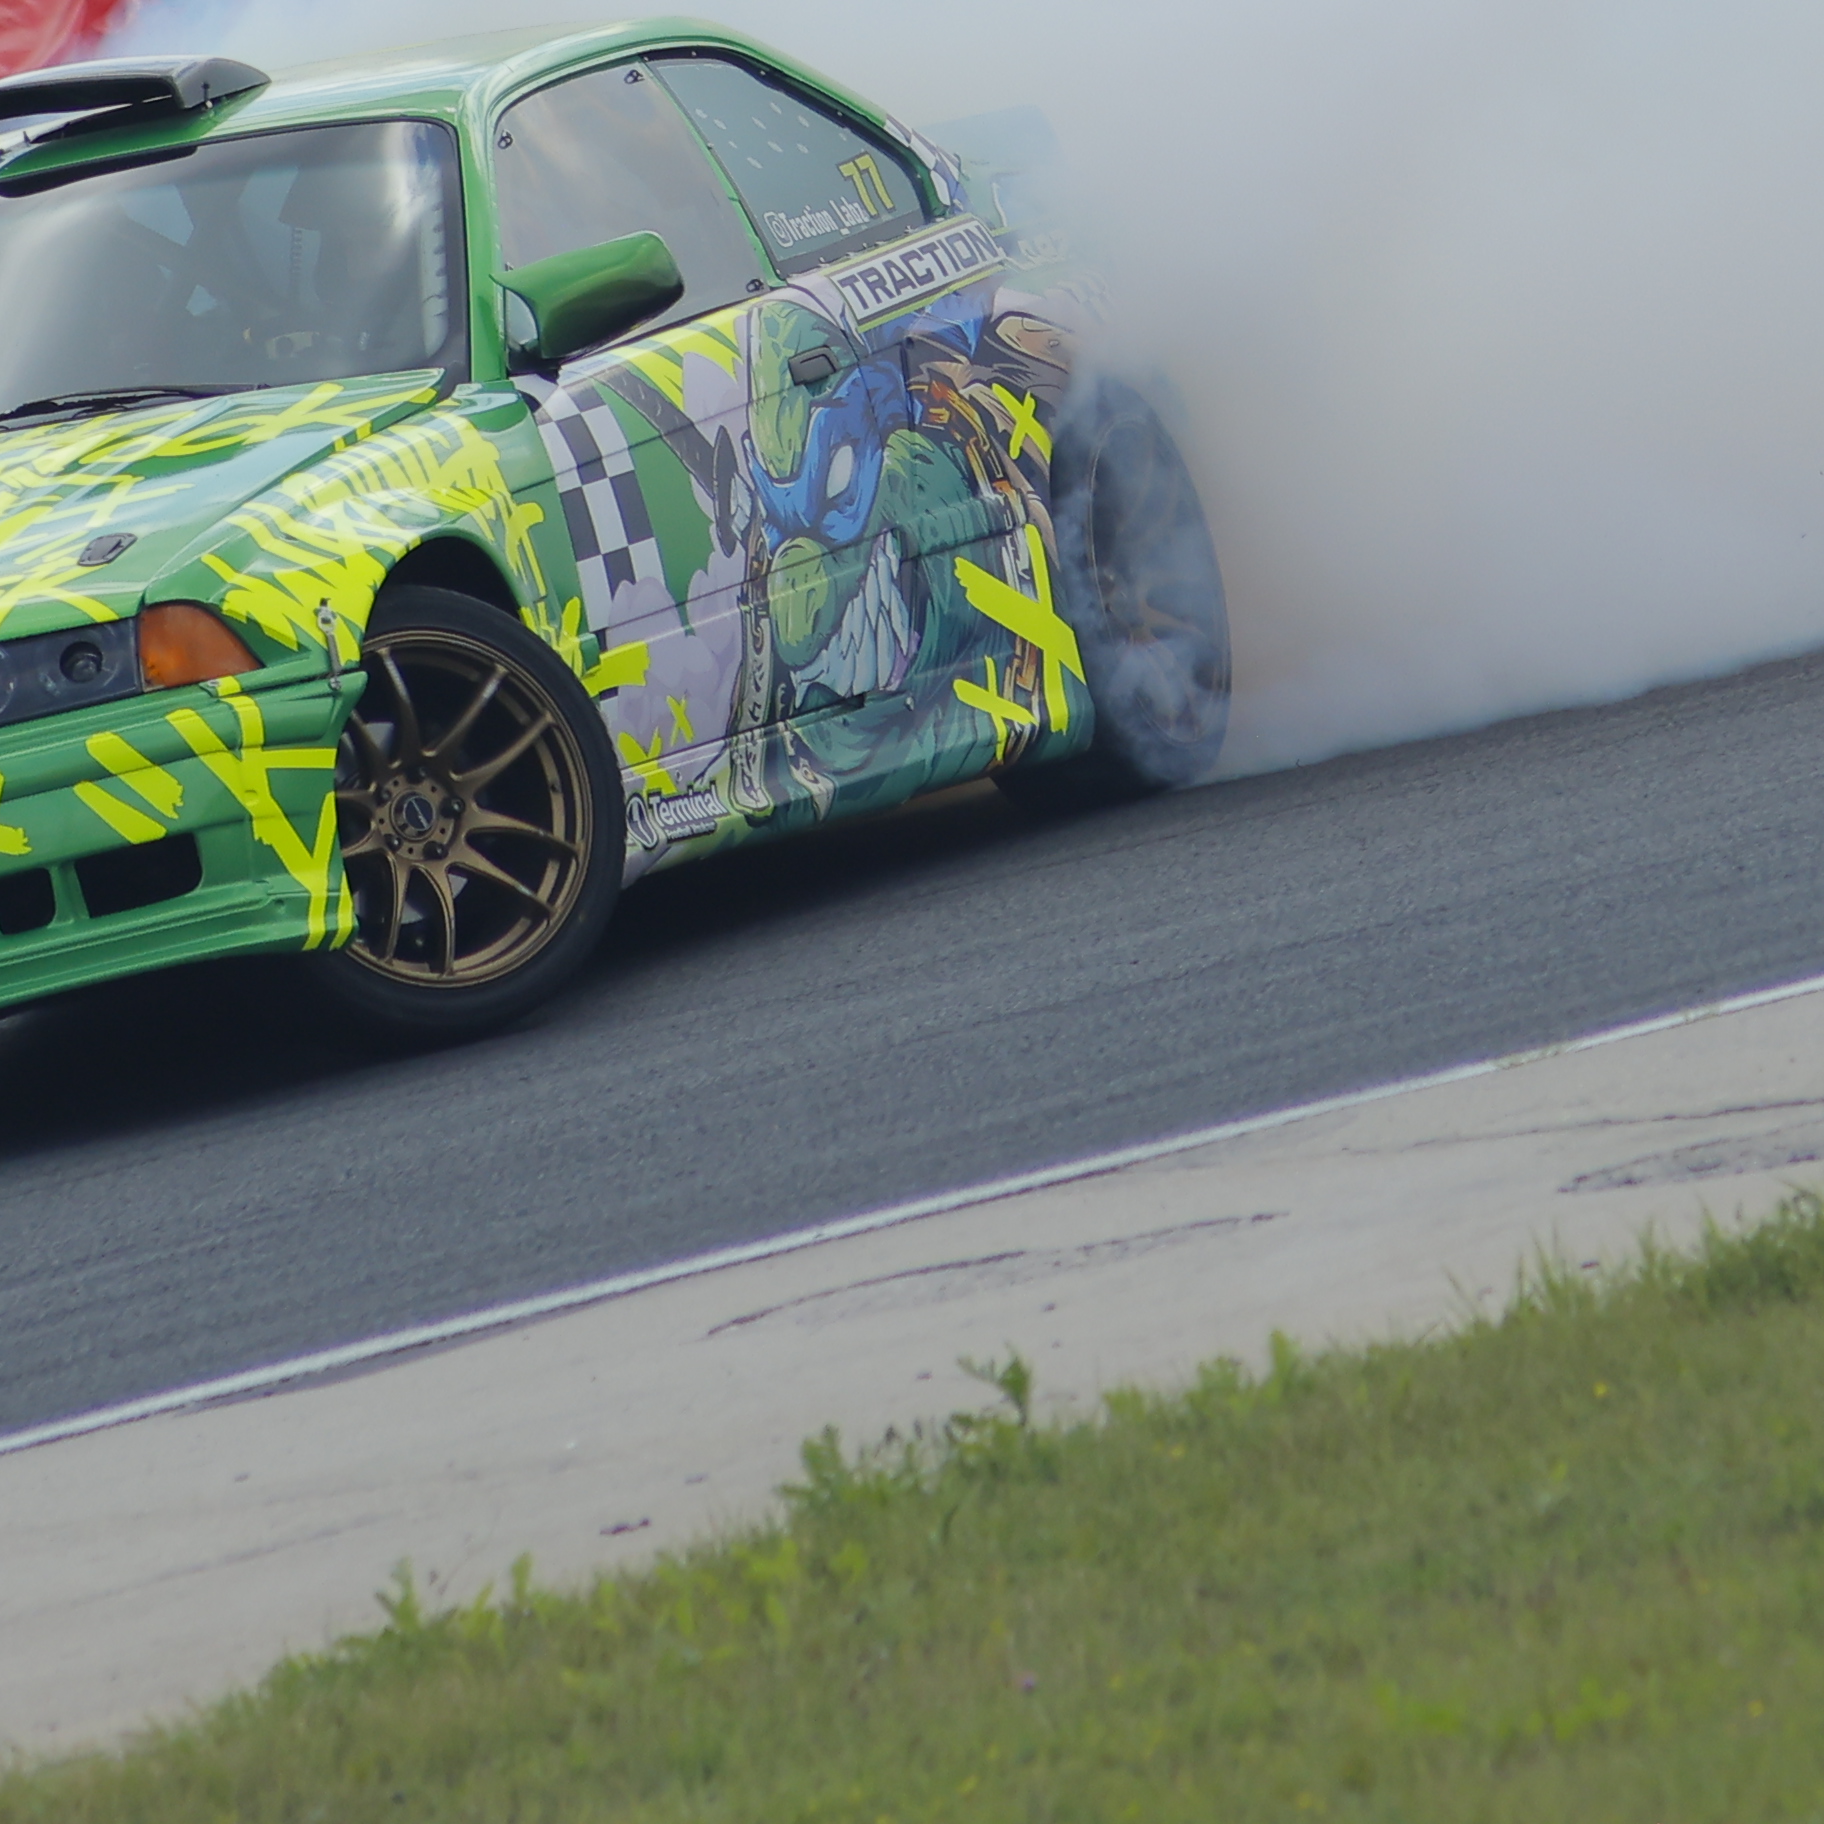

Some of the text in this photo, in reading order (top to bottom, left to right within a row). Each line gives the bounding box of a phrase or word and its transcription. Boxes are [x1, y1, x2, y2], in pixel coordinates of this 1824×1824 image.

[837, 152, 895, 217] 77
[837, 225, 1000, 310] TRACTION
[649, 784, 728, 827] Terminal
